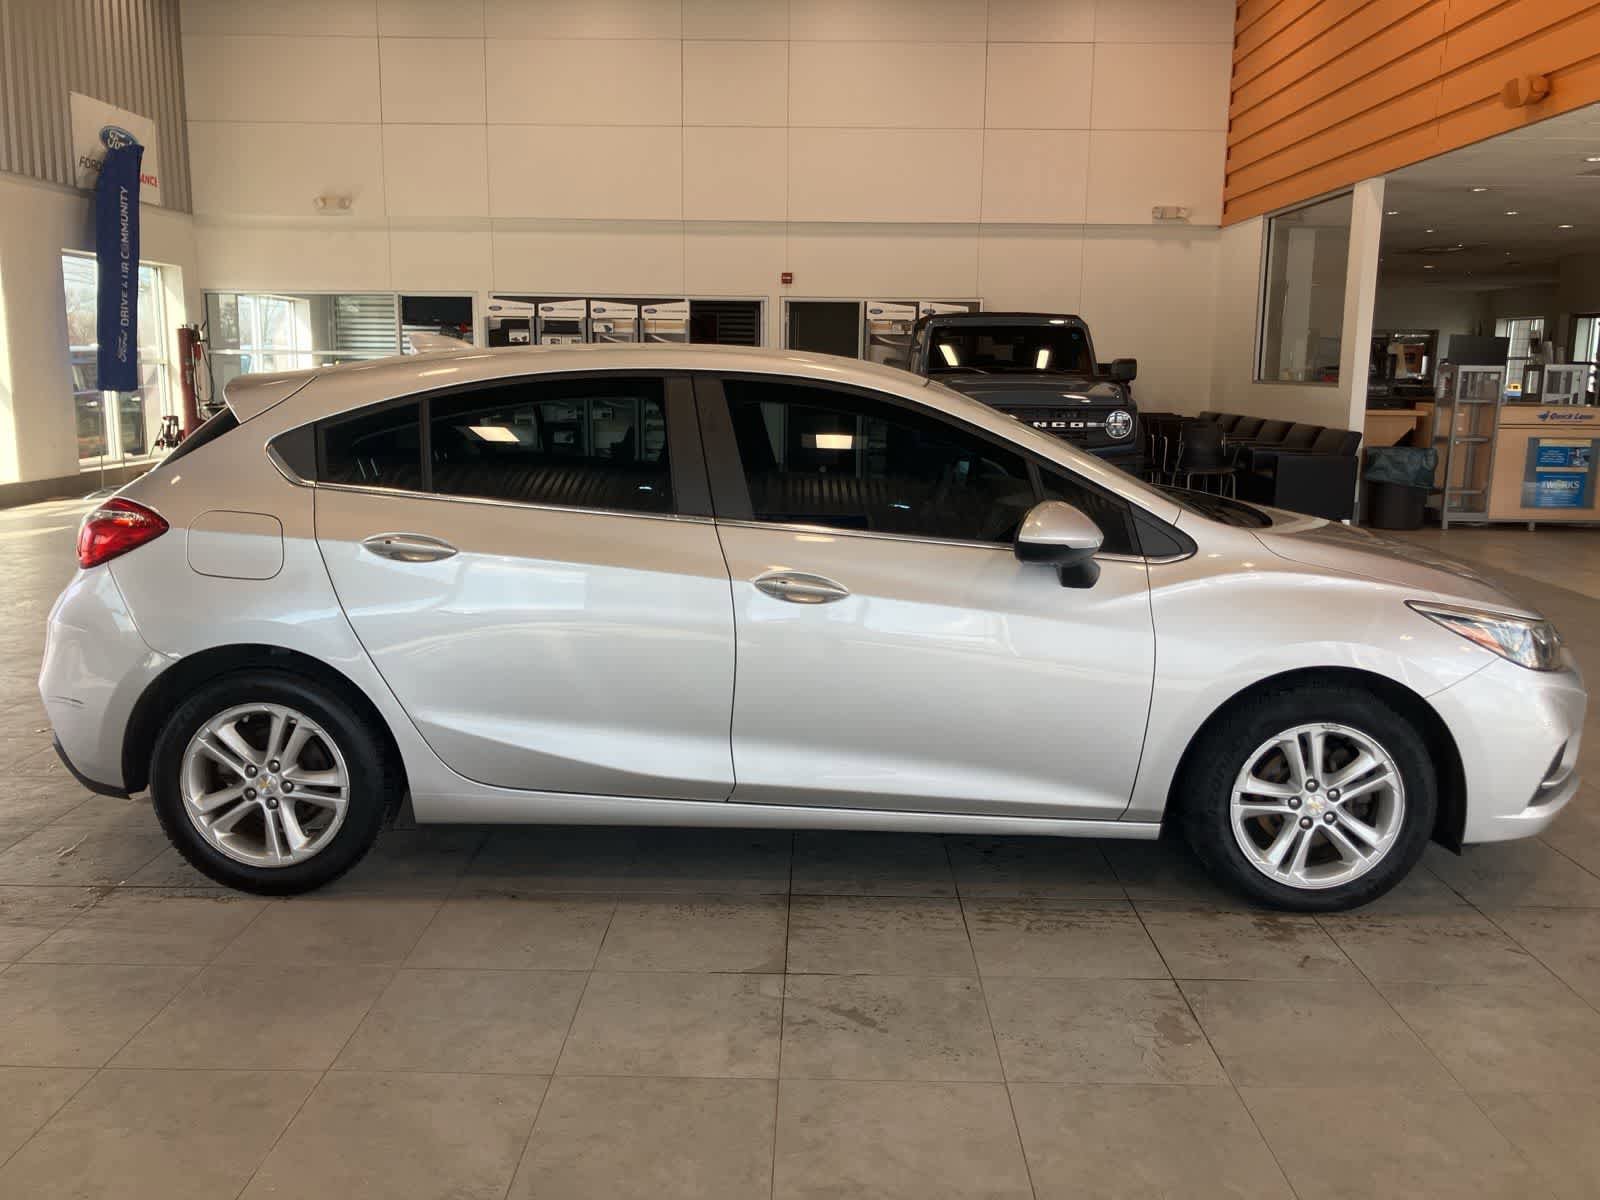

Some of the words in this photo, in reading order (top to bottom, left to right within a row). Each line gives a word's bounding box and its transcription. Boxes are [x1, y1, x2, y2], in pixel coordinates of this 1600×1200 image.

[108, 131, 133, 150] For
[140, 173, 157, 187] ANCE
[120, 288, 130, 327] DRIVE
